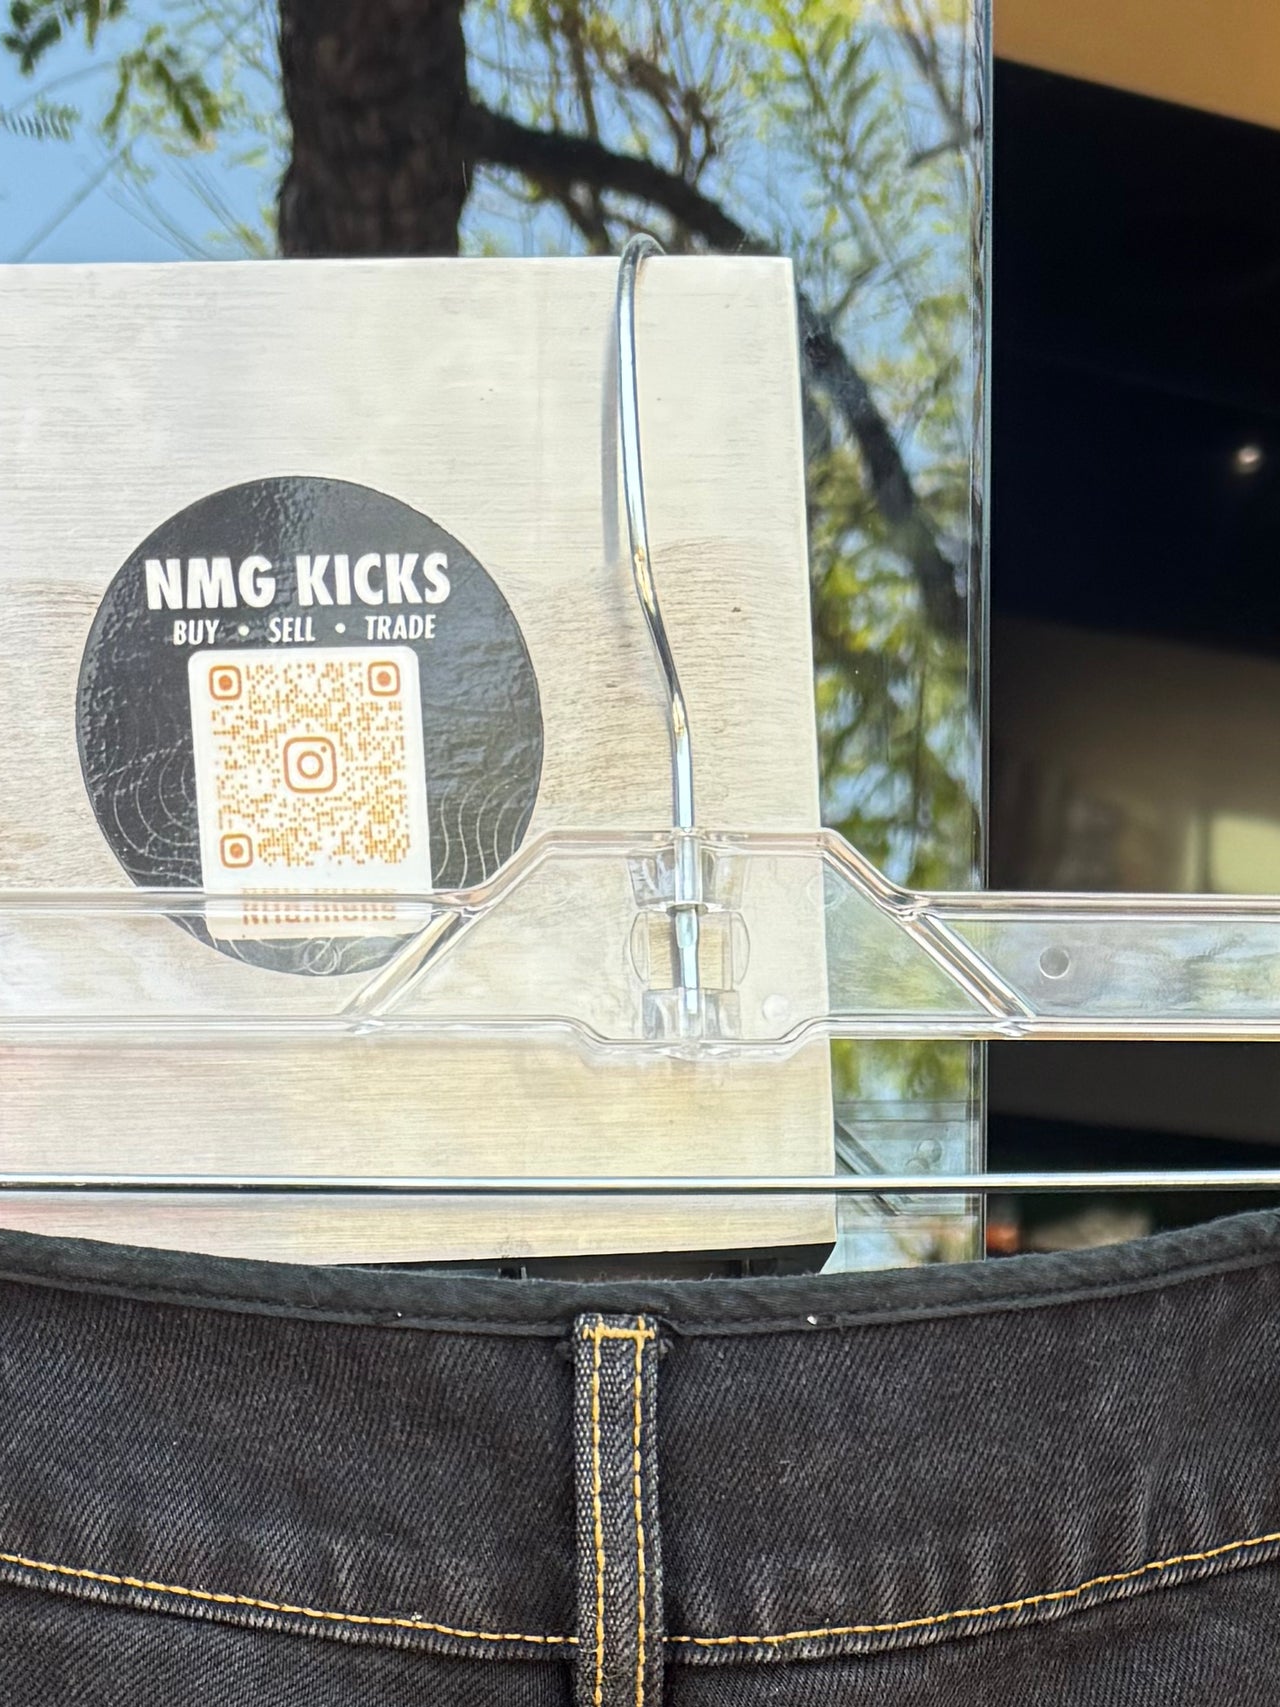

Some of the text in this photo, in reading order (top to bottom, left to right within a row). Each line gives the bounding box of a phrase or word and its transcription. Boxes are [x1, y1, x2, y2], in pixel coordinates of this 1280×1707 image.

[145, 552, 451, 610] NMG KICKS
[173, 614, 437, 646] BUY SELL TRADE
